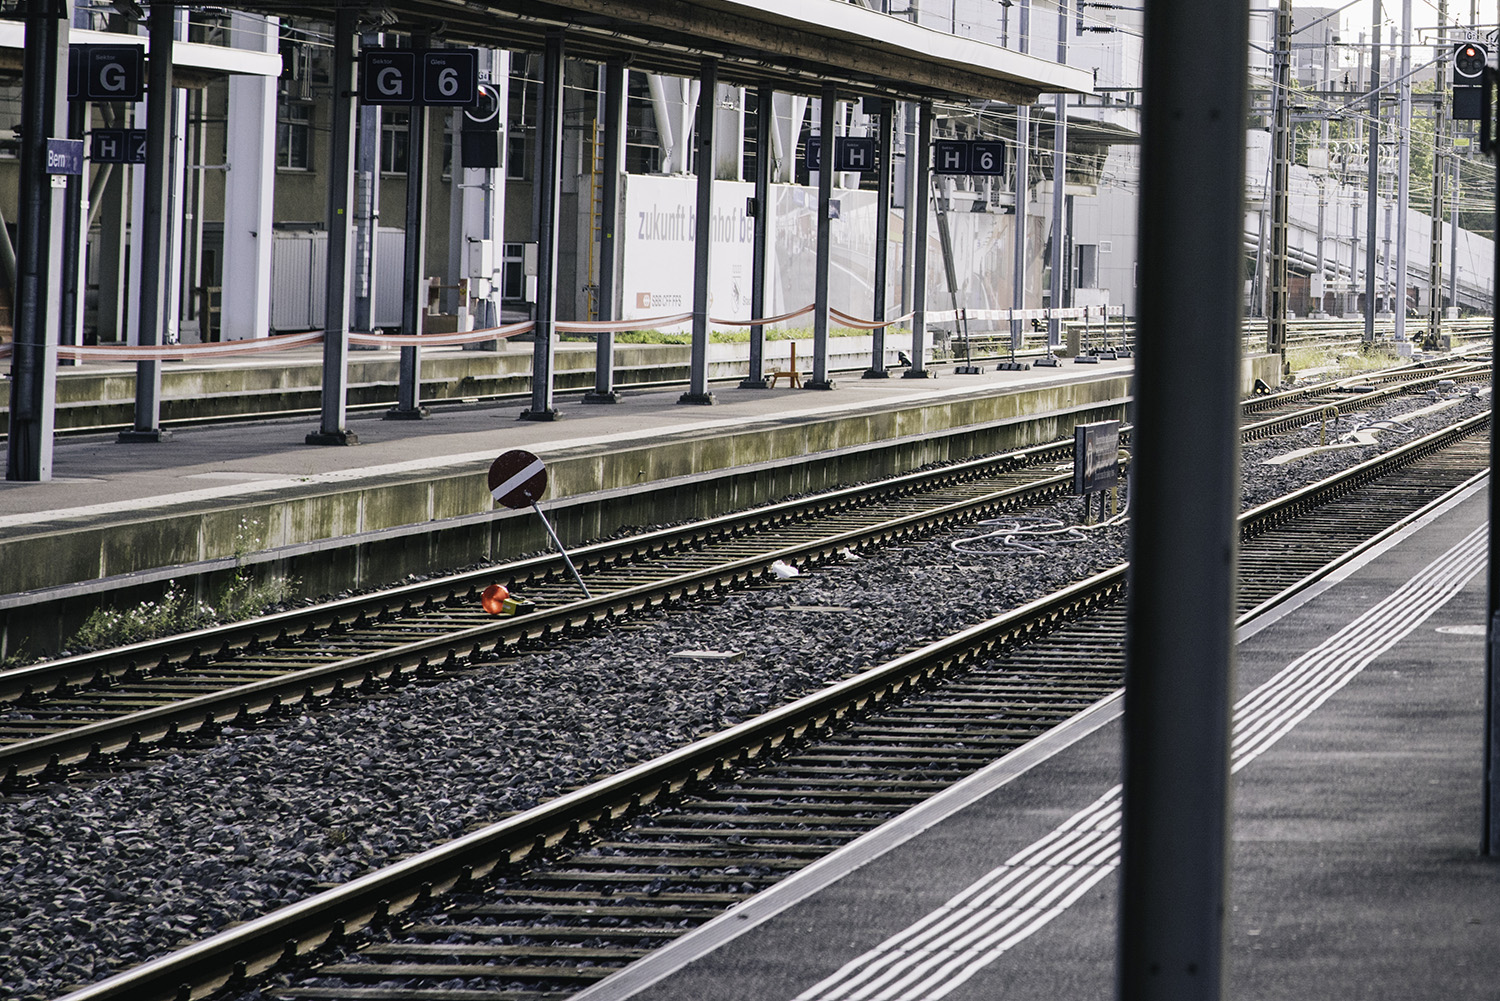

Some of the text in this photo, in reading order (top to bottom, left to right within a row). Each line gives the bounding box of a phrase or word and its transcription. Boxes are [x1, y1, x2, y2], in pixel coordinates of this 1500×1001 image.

[100, 63, 126, 91] G
[377, 67, 458, 96] G 6
[101, 140, 146, 158] H 4
[850, 149, 864, 166] H
[48, 150, 65, 168] Bern
[945, 152, 994, 170] H 6
[638, 204, 685, 241] zukunft
[689, 205, 737, 243] bnhof
